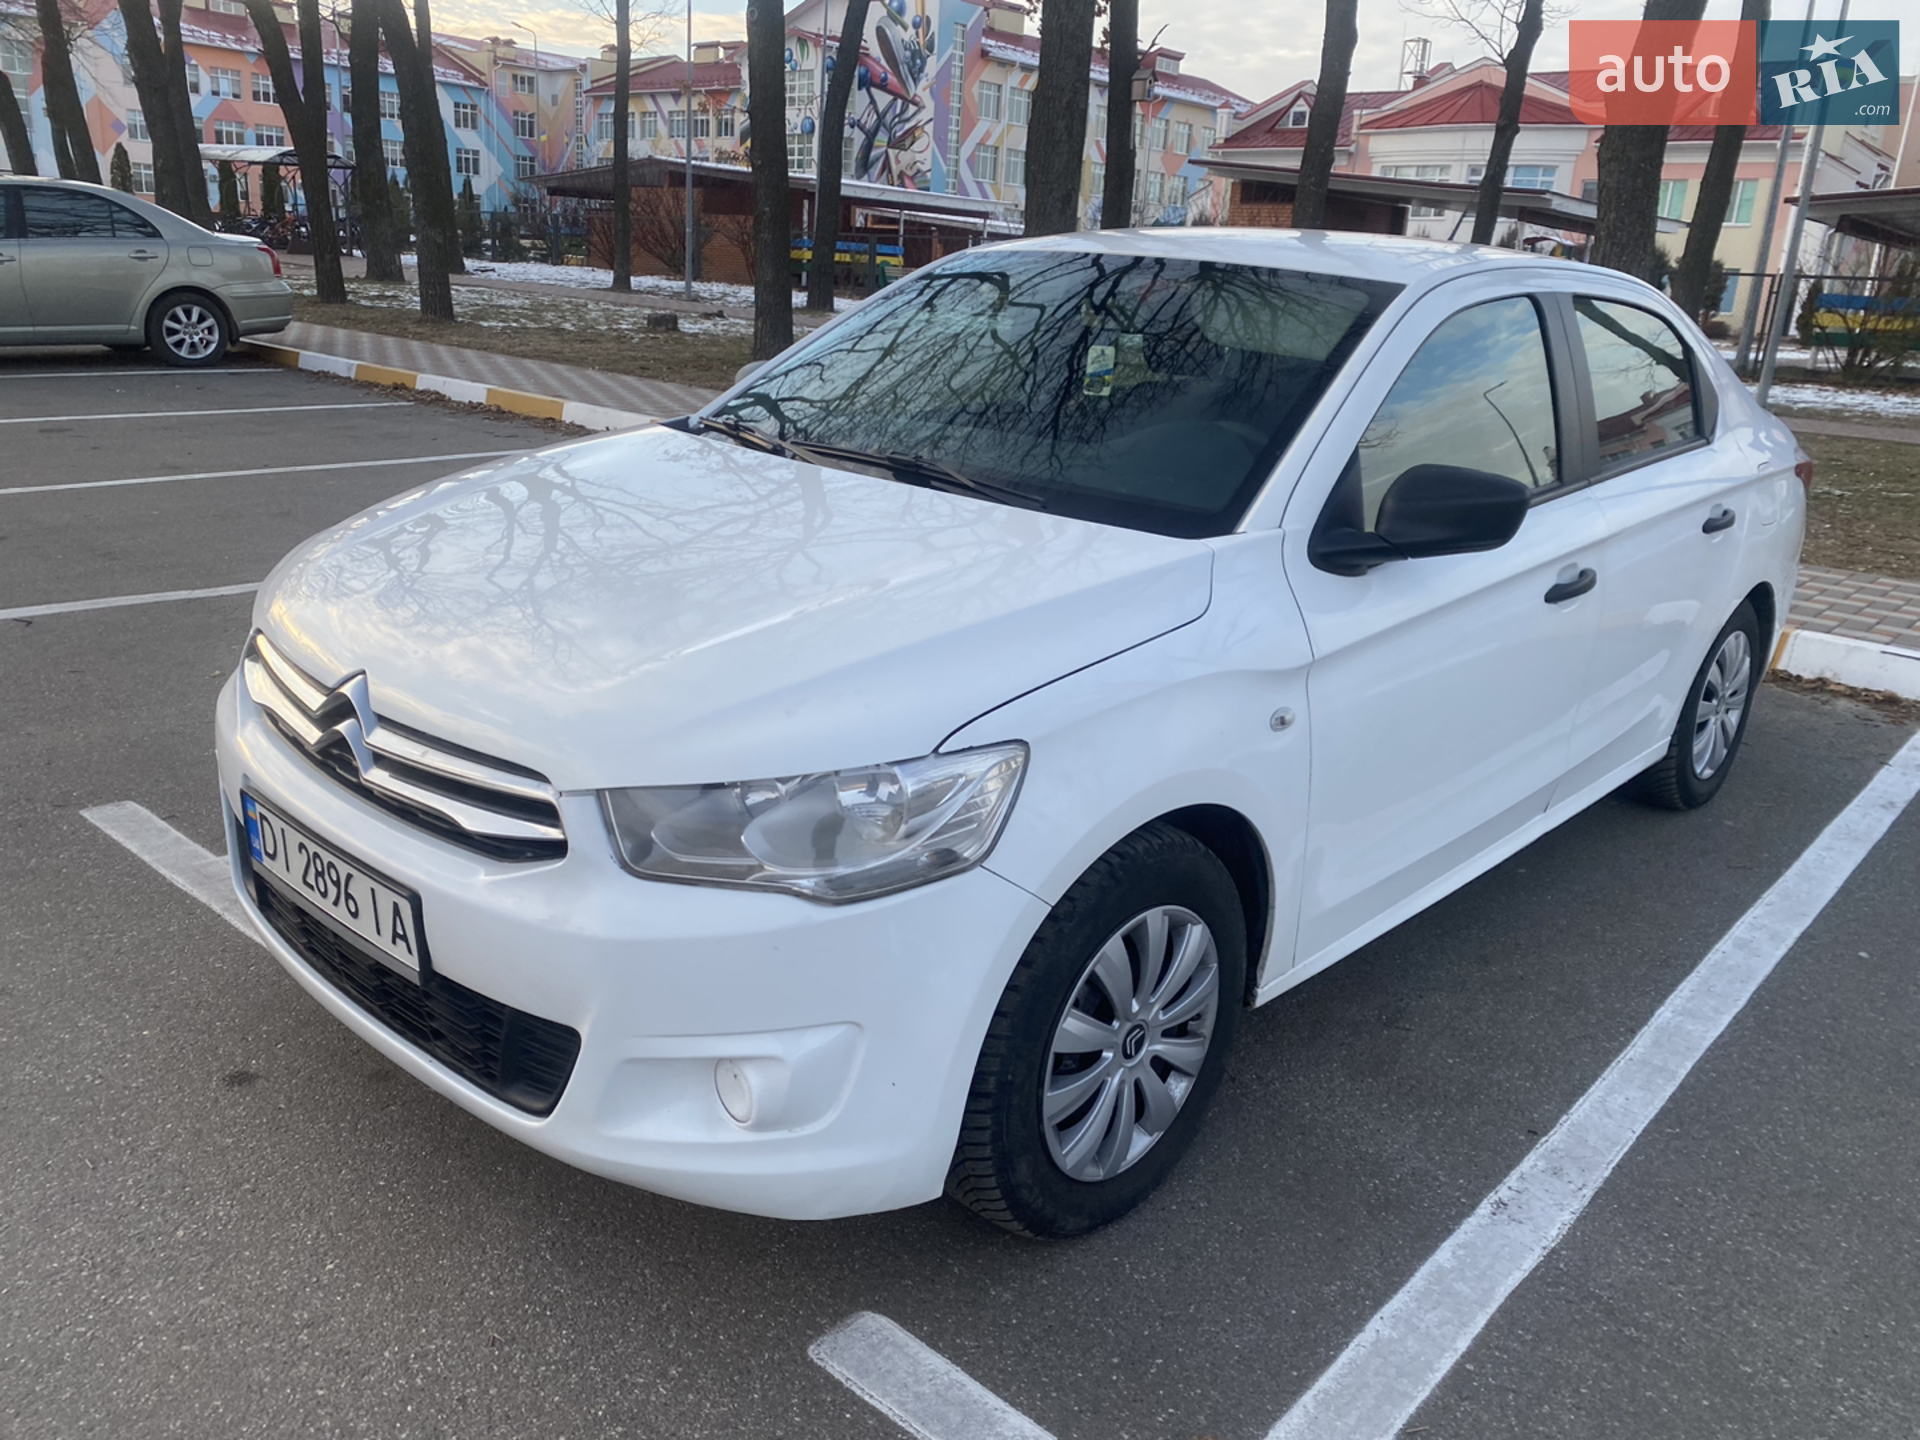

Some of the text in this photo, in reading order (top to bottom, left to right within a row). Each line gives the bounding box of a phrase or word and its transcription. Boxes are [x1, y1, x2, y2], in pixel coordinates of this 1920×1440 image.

[259, 811, 413, 956] DI 2896 IA
